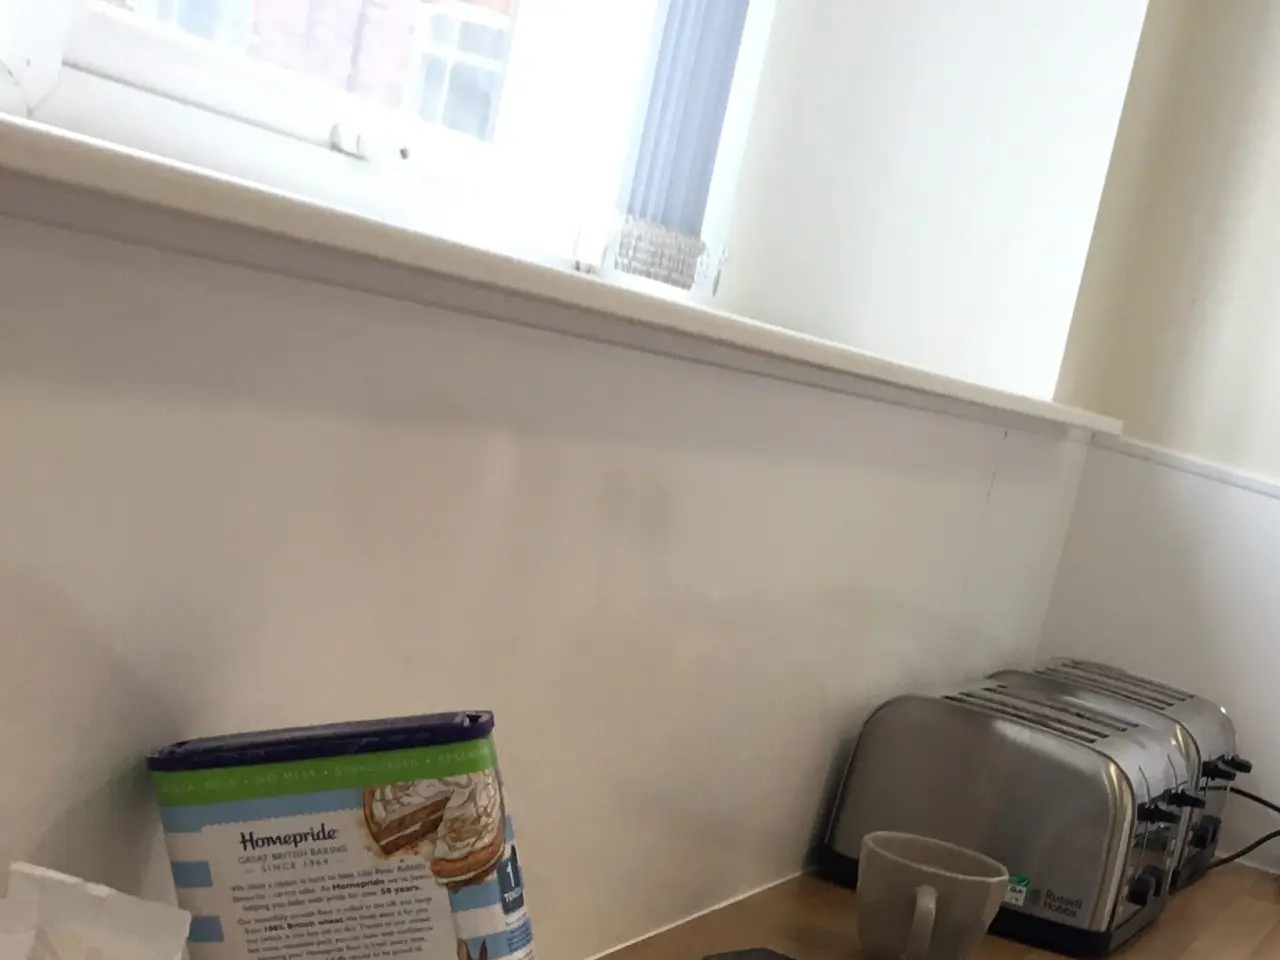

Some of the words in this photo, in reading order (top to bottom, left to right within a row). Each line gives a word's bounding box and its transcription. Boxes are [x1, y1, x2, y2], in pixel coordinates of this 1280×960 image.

[239, 827, 338, 854] Homepride
[271, 848, 307, 861] BRITISH
[309, 843, 347, 857] BAKING
[260, 861, 297, 873] SINCE
[1045, 889, 1083, 910] Russell
[1043, 900, 1078, 918] Hobbs
